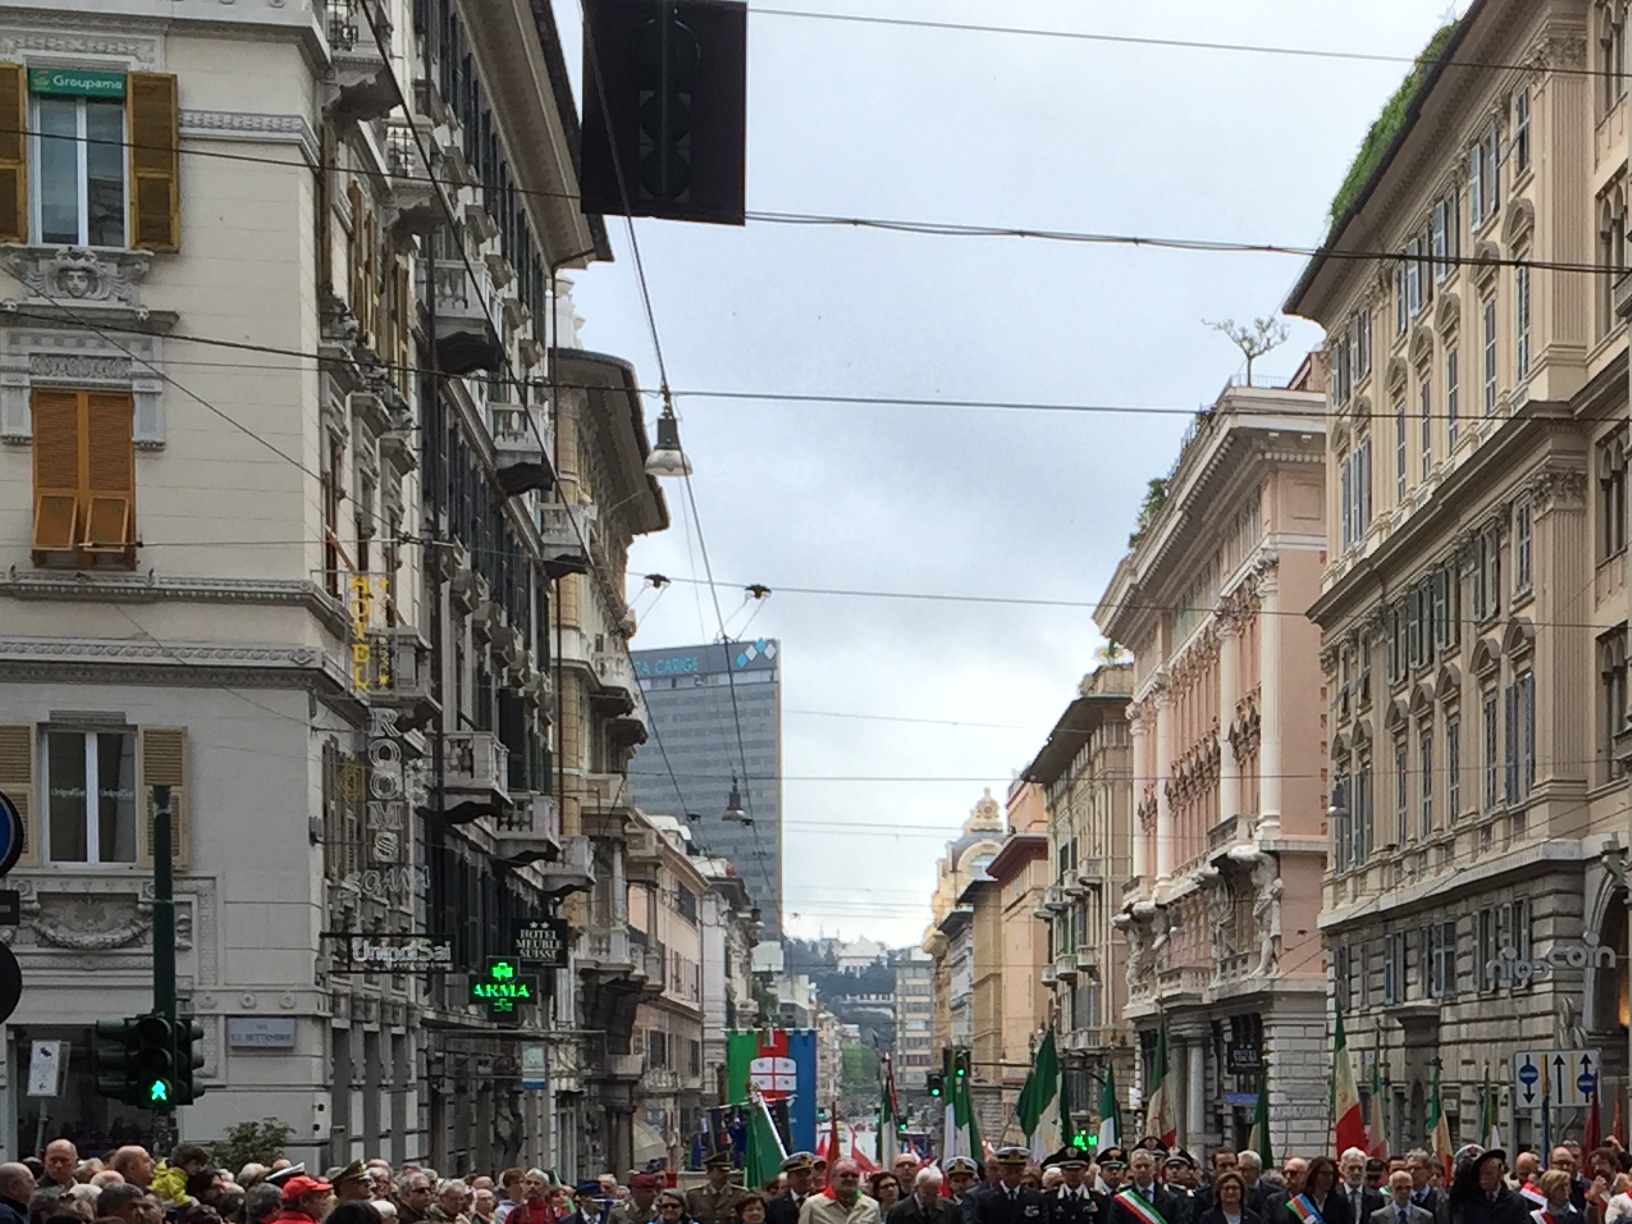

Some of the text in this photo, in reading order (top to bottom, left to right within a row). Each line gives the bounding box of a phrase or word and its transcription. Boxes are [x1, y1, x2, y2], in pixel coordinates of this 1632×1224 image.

[53, 74, 122, 90] Groupama
[350, 575, 371, 690] HOTEL
[654, 656, 698, 674] CARIGE
[366, 707, 404, 863] ROOMS
[520, 929, 557, 940] HOTEL
[352, 939, 451, 968] UnipolSai
[520, 948, 557, 959] SUISSE
[1547, 931, 1617, 968] coin
